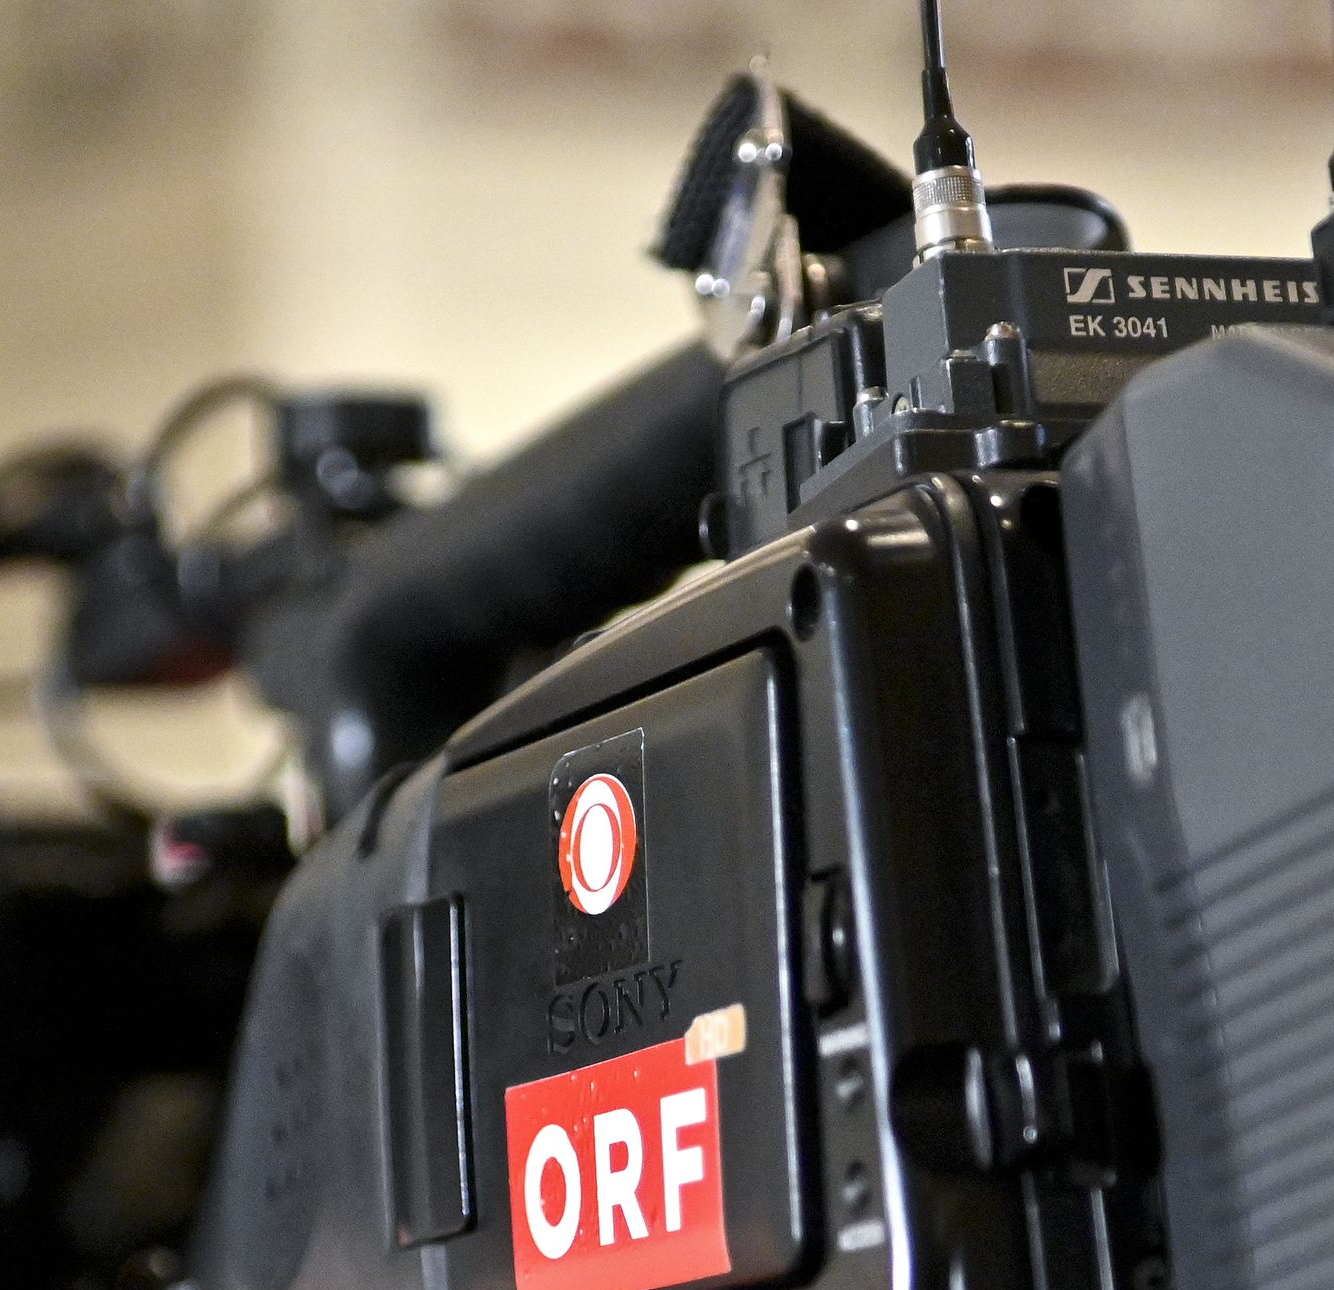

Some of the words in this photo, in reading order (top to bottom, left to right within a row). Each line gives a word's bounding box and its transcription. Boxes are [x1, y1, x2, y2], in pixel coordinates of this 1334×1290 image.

[1127, 275, 1319, 304] SENNHEIS
[1069, 315, 1106, 337] EK
[1114, 316, 1168, 338] 3041
[548, 960, 683, 1050] SONY
[524, 1087, 706, 1260] ORF
